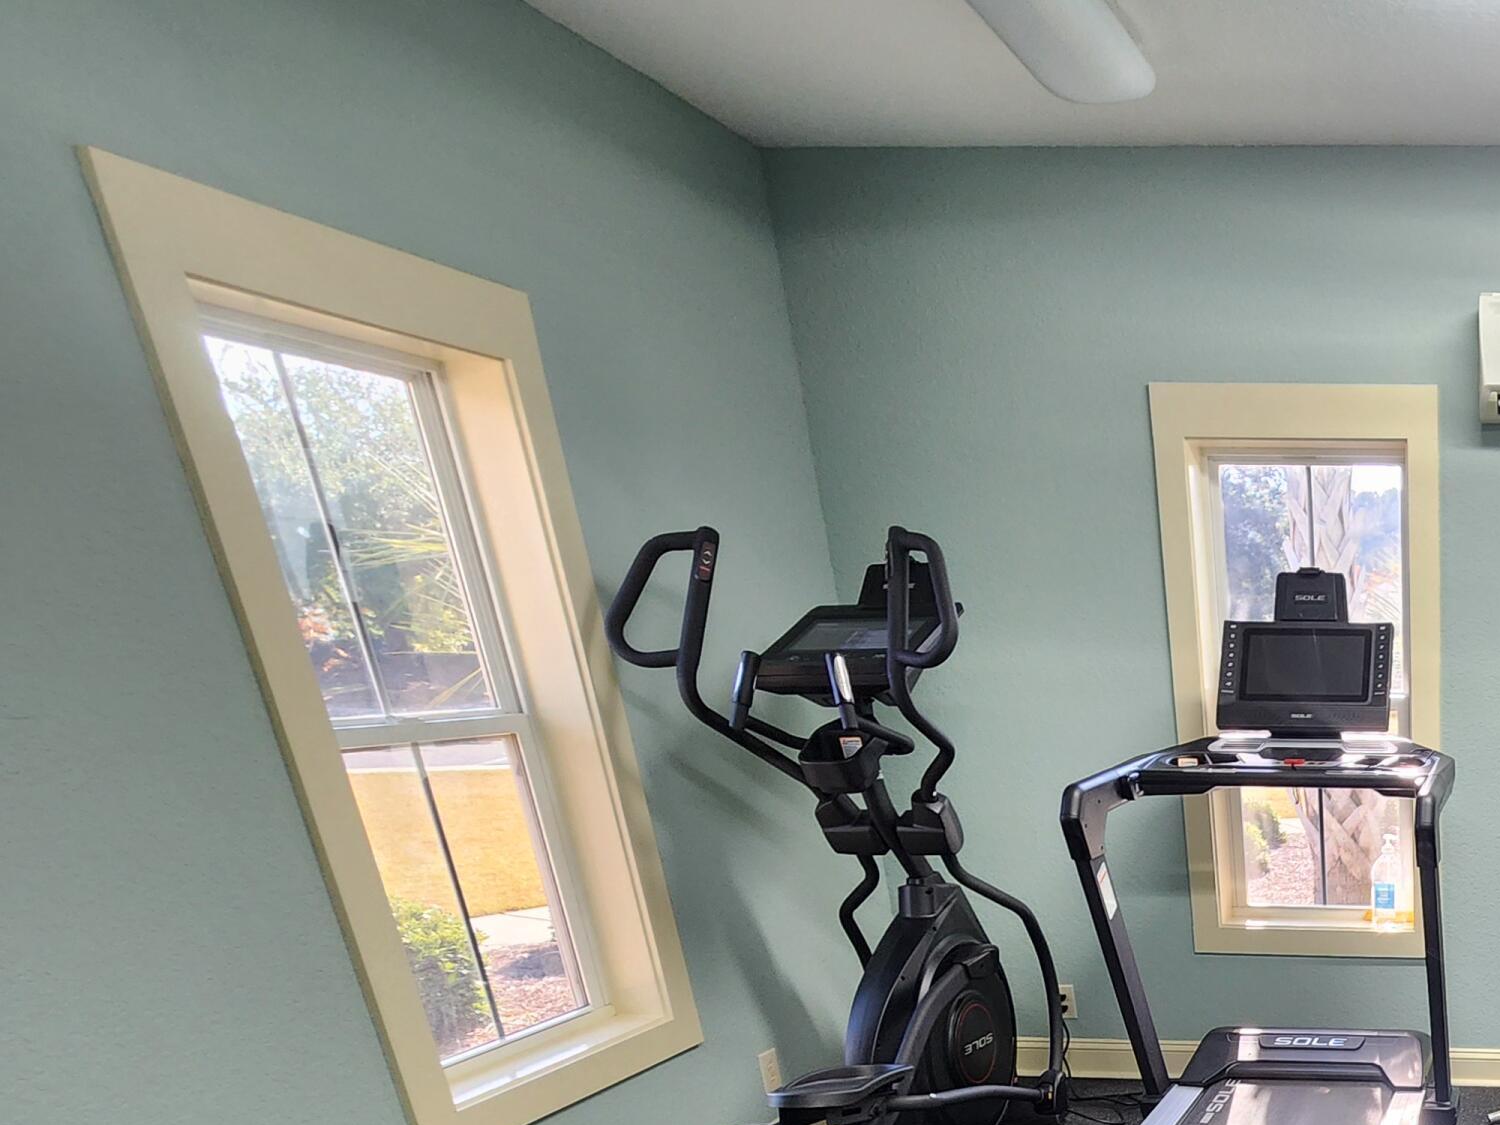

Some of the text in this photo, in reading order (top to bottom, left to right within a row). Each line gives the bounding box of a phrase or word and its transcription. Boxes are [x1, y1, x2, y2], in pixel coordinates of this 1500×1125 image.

[964, 1032, 993, 1056] SOLE
[1273, 1036, 1348, 1047] SOLE
[1205, 1078, 1241, 1113] SOLE
